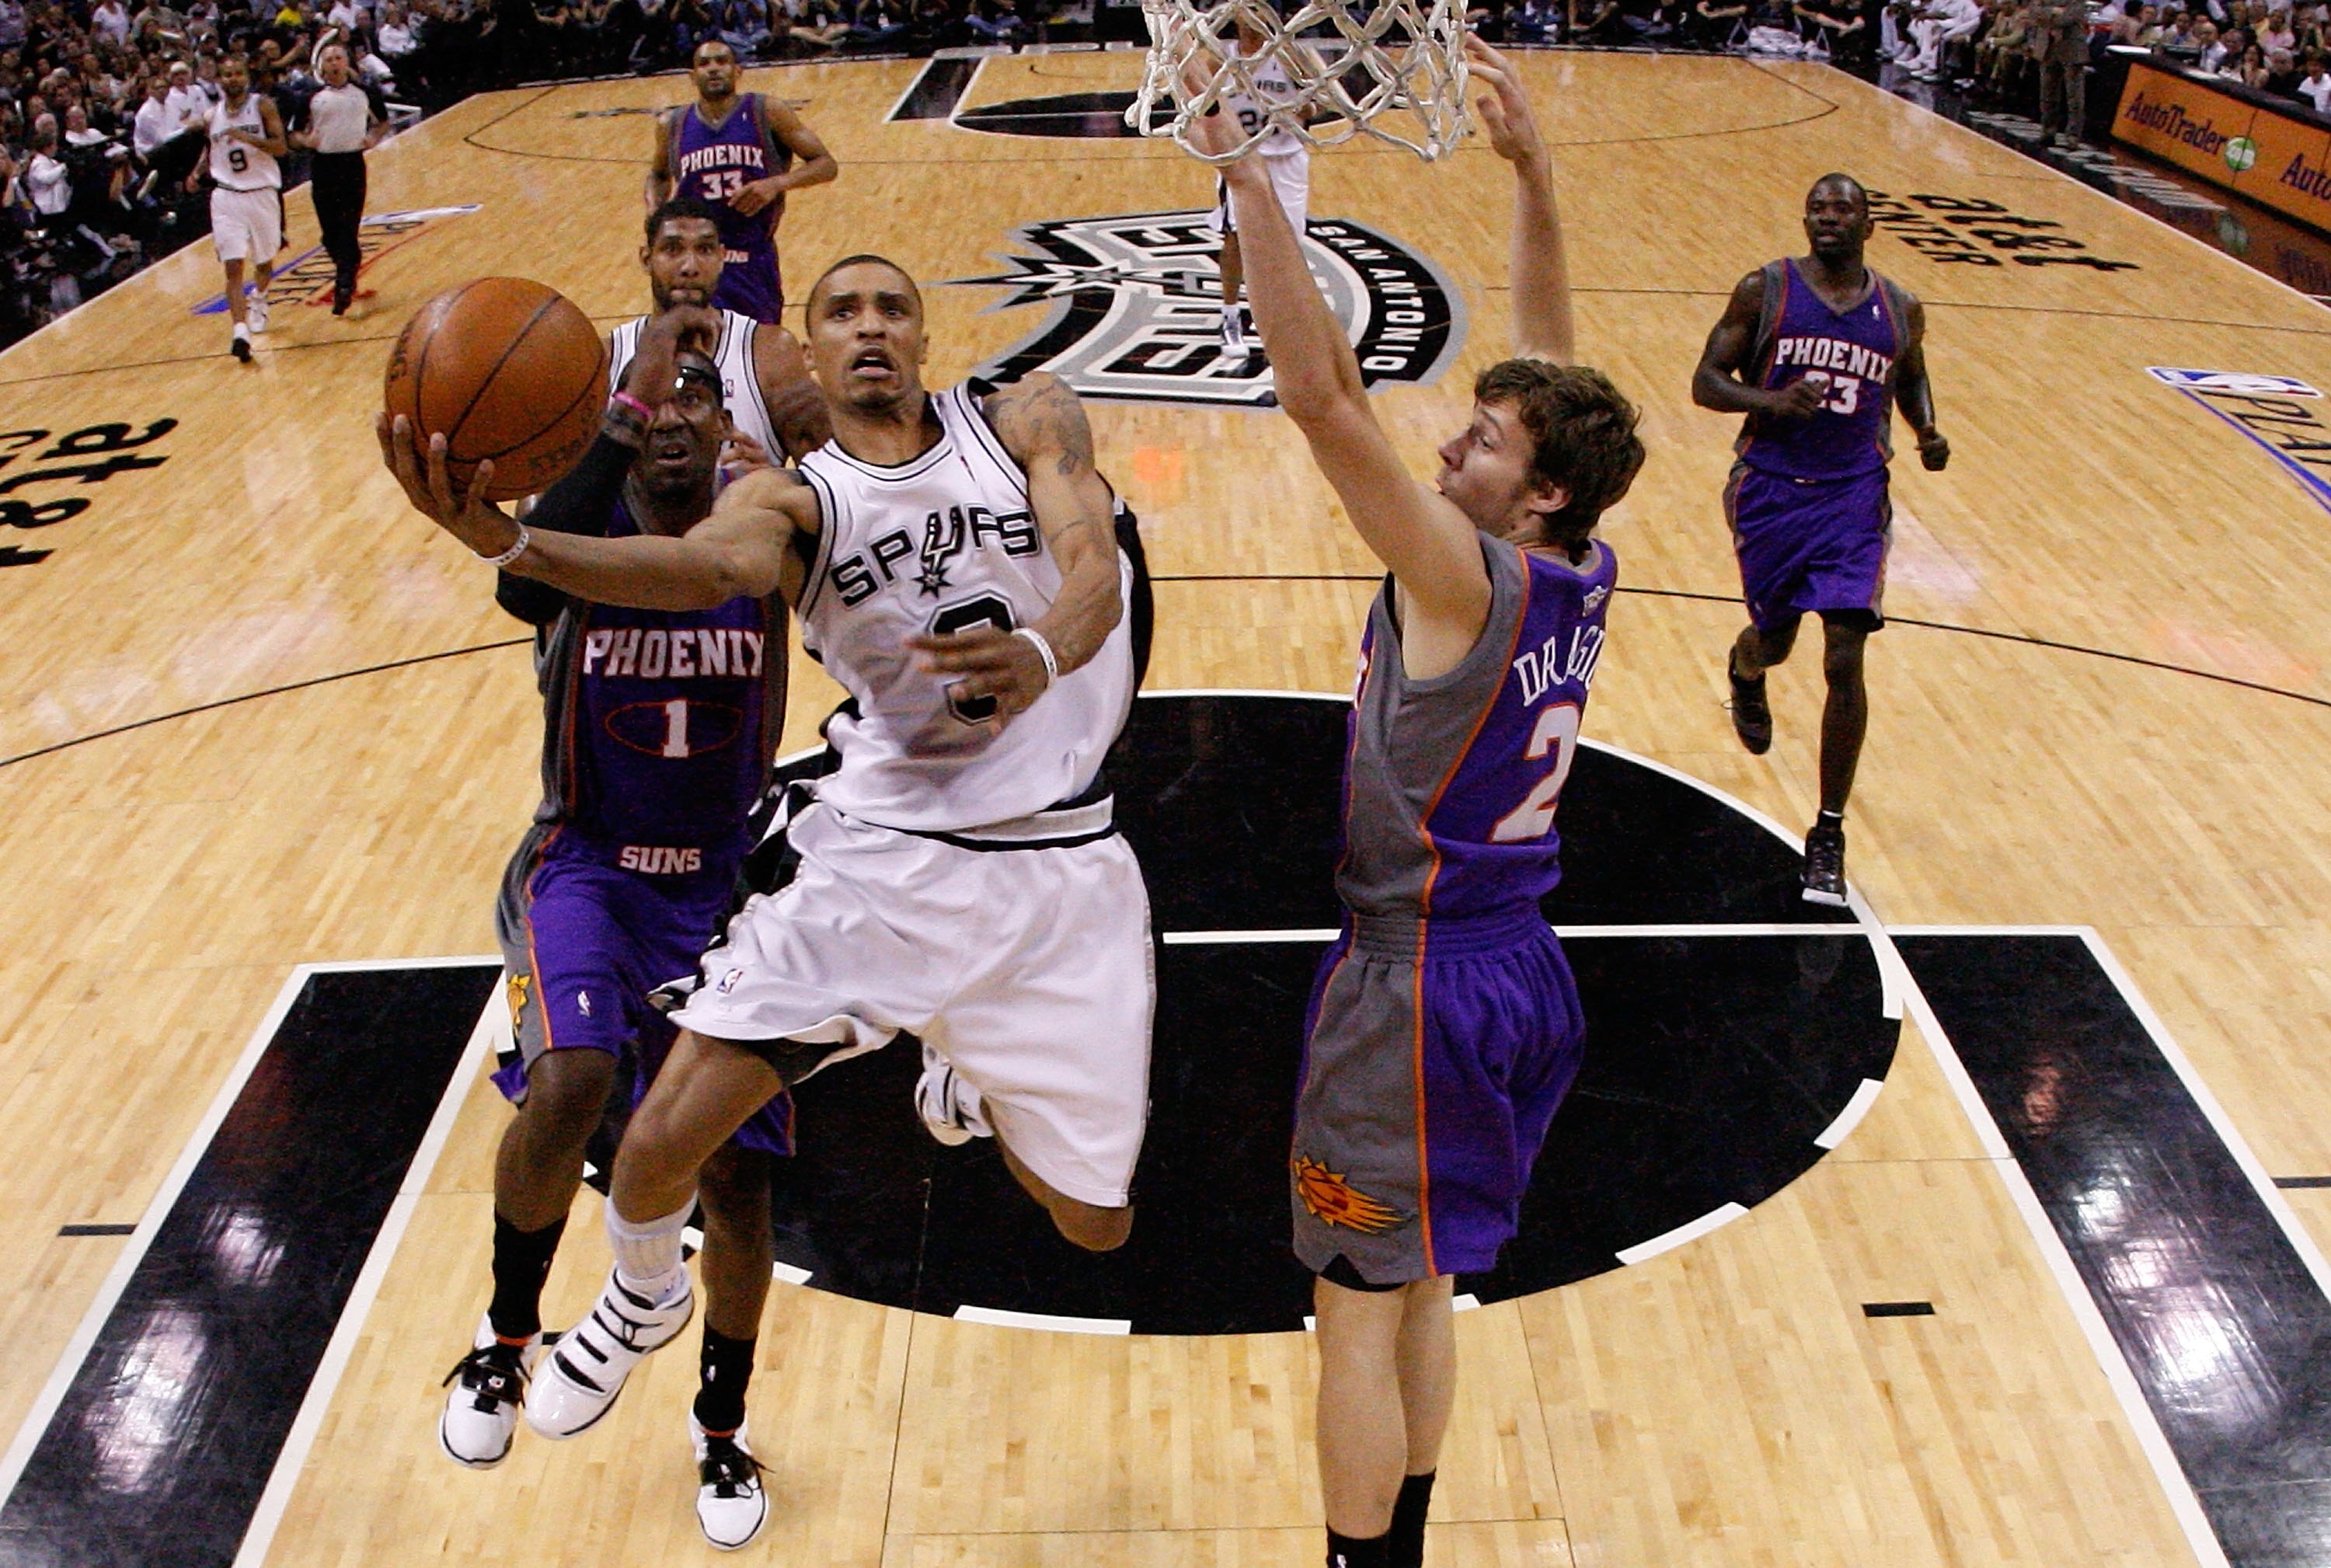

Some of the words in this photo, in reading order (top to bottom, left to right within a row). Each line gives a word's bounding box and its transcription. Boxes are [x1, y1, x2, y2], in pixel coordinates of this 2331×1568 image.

[2124, 91, 2229, 155] AutoTrader
[229, 148, 248, 172] 9
[680, 144, 765, 178] PHOENIX
[702, 169, 744, 200] 33
[1308, 225, 1389, 260] SAN
[1361, 267, 1426, 371] ANTONIO
[1775, 337, 1894, 385] PHOENIX
[830, 504, 1043, 610] SPURS
[583, 629, 765, 678] PHOENIX
[663, 699, 690, 759] 1
[1486, 701, 1580, 843] 2
[620, 845, 702, 874] SUNS
